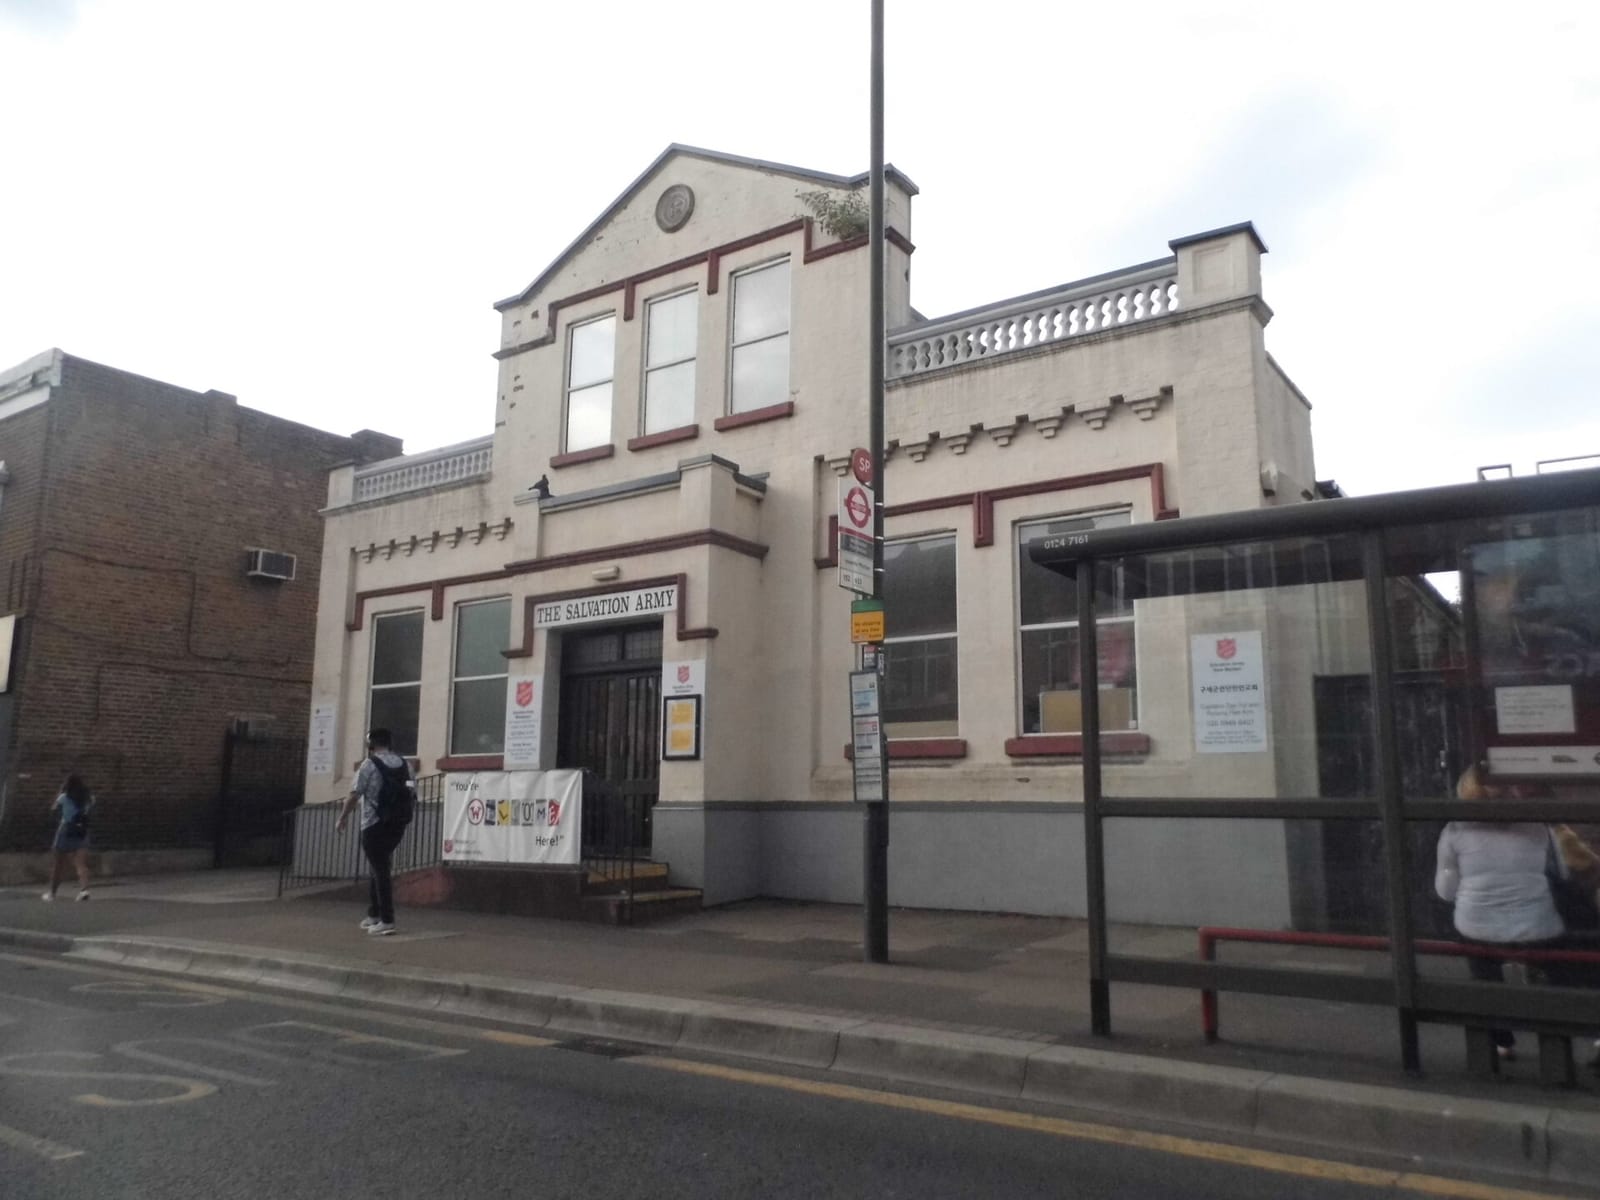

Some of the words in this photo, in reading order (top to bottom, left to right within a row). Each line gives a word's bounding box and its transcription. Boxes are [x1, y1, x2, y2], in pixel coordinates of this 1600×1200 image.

[858, 457, 871, 473] SP
[536, 605, 562, 624] THE
[566, 596, 630, 621] SALVATION
[635, 589, 675, 612] ARMY
